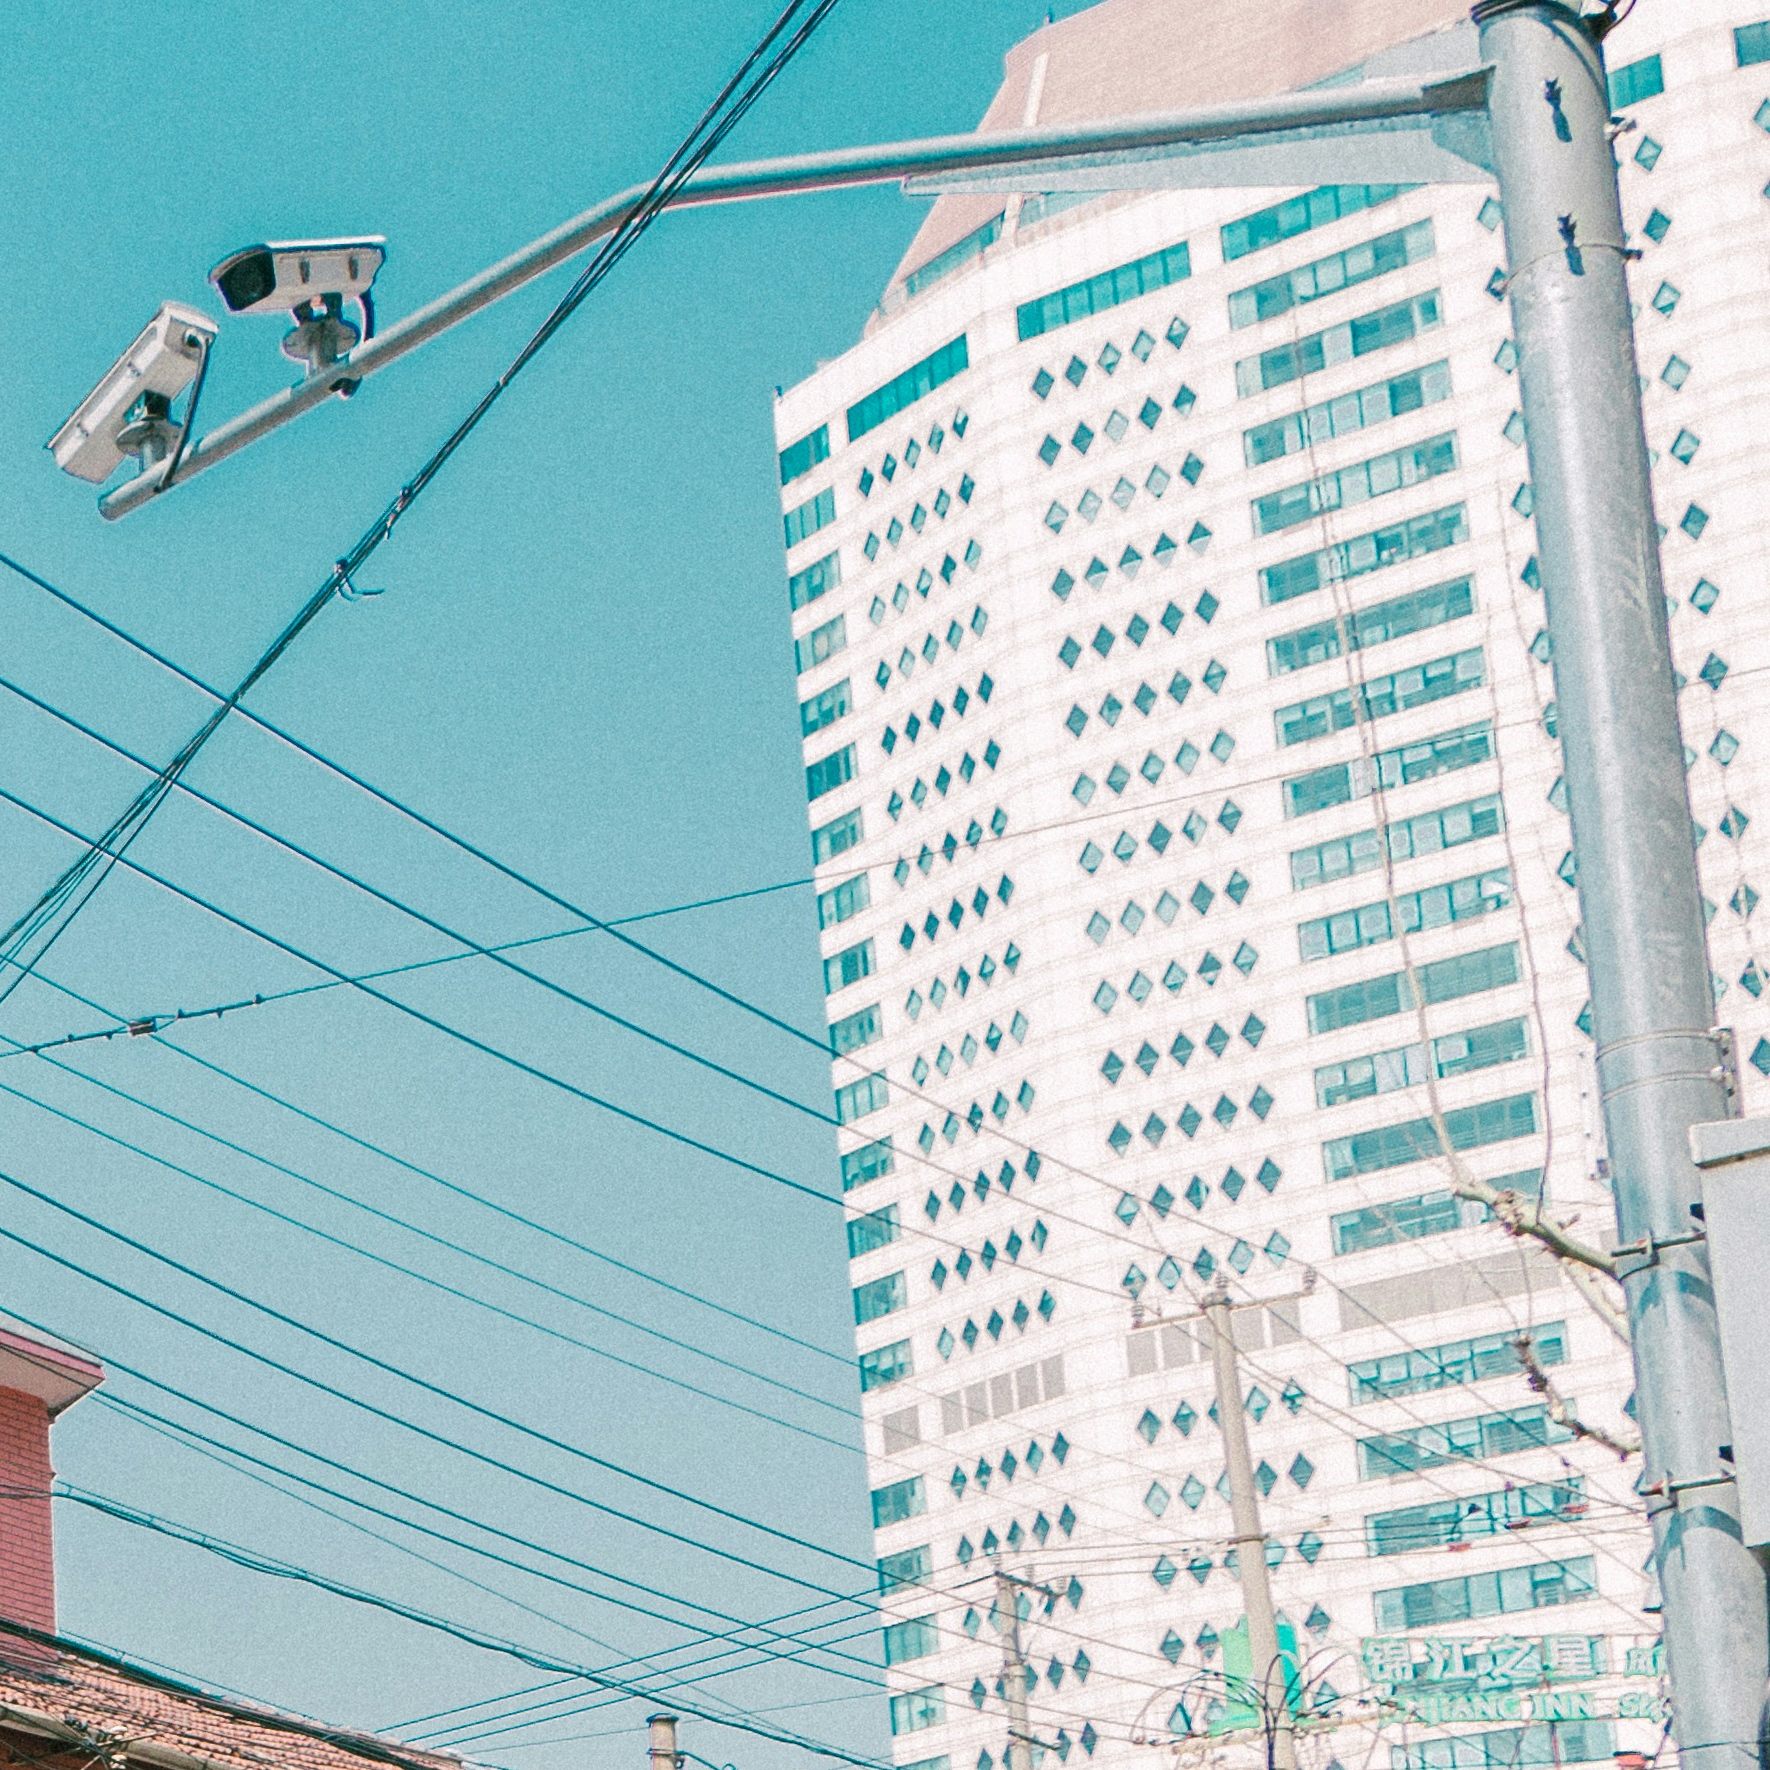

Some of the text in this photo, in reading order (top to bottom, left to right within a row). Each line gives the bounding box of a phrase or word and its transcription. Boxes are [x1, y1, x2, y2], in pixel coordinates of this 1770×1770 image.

[1363, 1634, 1596, 1684] 锦江之星
[1379, 1692, 1522, 1727] NJIANG
[1531, 1693, 1595, 1720] INN
